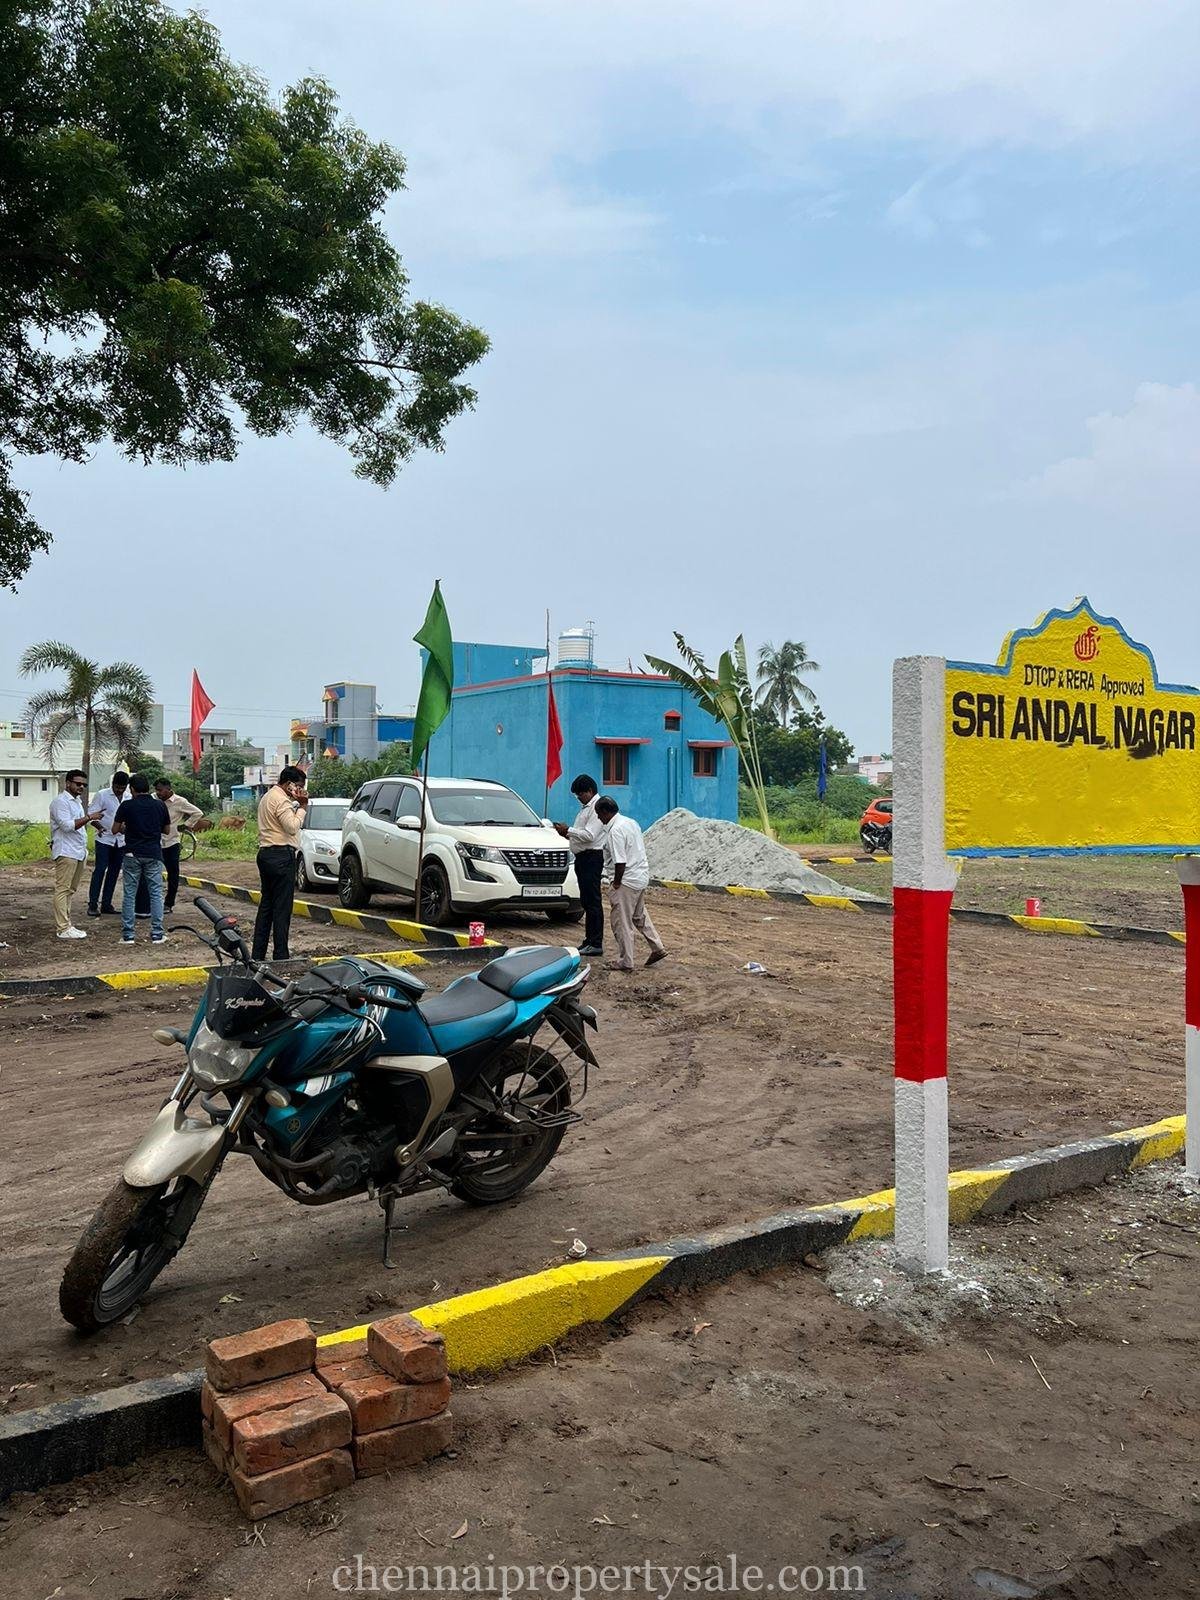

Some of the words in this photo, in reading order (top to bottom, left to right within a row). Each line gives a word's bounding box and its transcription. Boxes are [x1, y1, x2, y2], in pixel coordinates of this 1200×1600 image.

[1024, 664, 1056, 688] DTCP
[1066, 669, 1095, 691] RERA
[1101, 673, 1145, 700] Approved
[952, 691, 1005, 739] SRI
[1010, 696, 1107, 746] ANDAL
[1114, 705, 1196, 752] NAGAR
